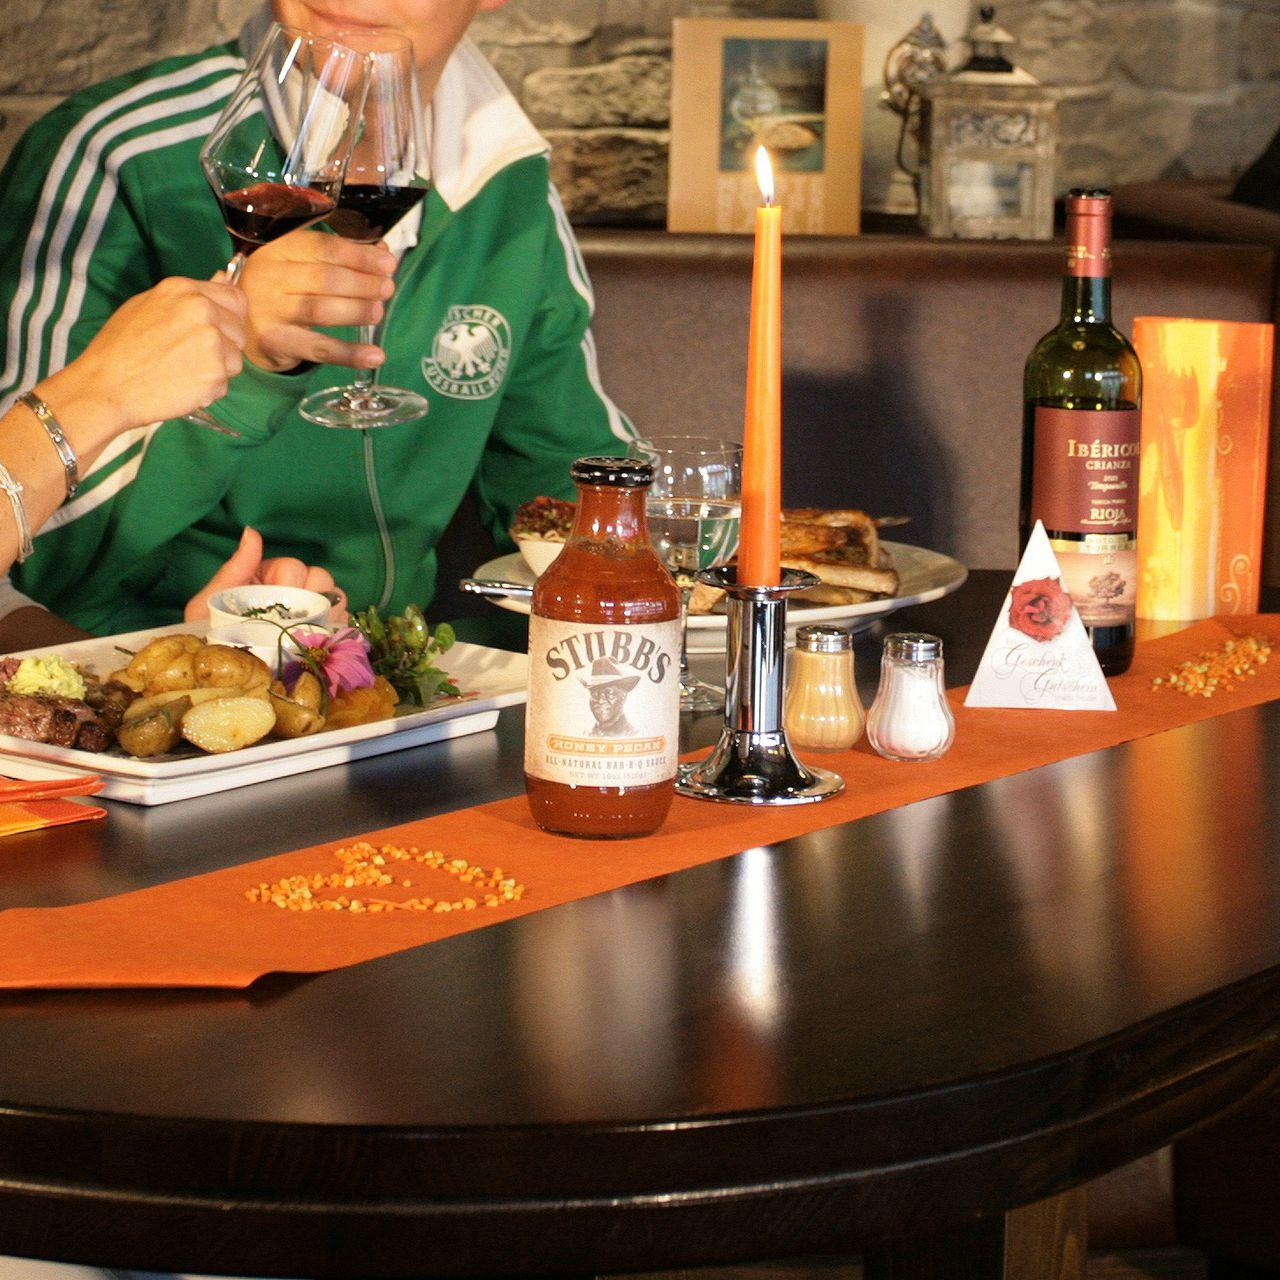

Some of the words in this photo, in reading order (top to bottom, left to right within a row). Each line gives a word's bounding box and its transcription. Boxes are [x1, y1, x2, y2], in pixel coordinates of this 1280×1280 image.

[1085, 460, 1131, 470] CRIANZA
[1090, 508, 1127, 521] RIOJA
[546, 630, 671, 684] STUBB'S
[555, 739, 608, 753] HONEY
[612, 740, 661, 753] PECAN
[646, 756, 667, 768] SAUCE
